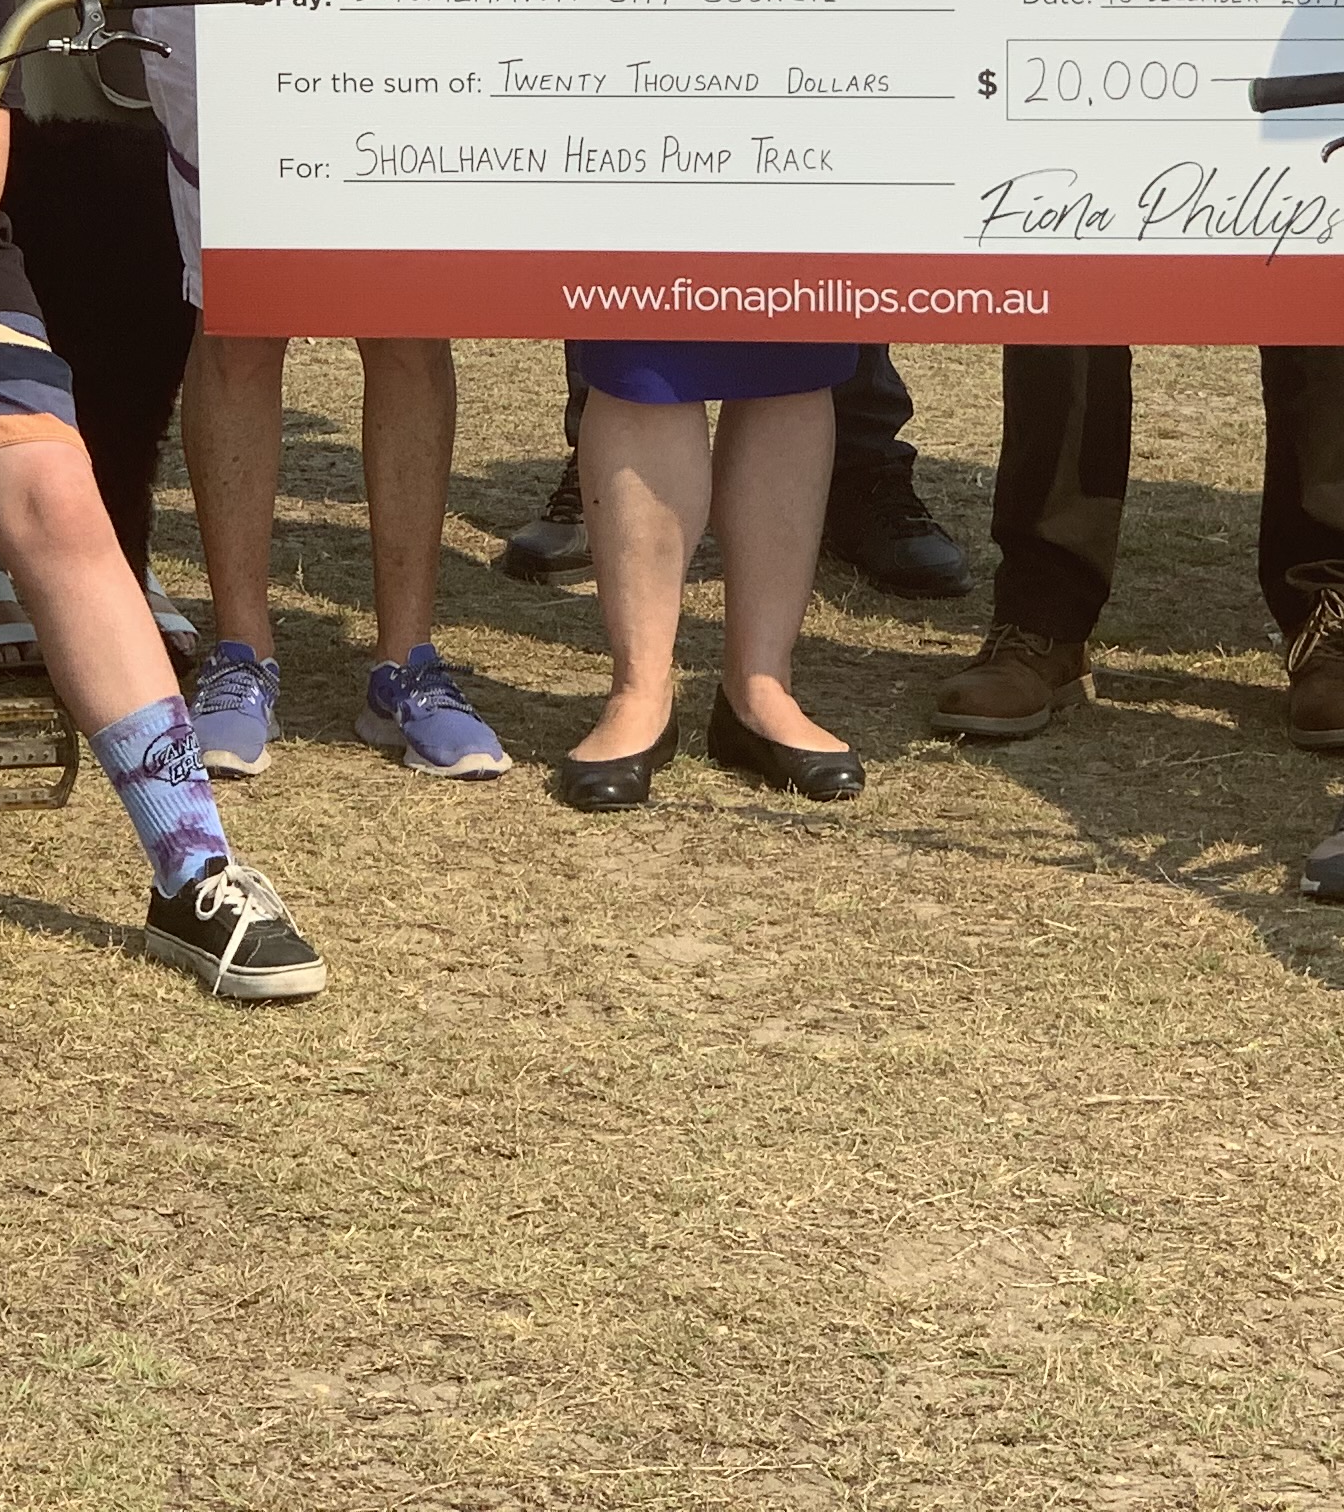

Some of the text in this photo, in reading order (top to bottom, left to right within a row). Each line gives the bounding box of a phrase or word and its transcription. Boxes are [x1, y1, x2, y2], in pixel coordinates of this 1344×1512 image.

[278, 58, 890, 95] For the sum of: TWENTY THOUSAND DOLLARS
[977, 57, 1200, 107] $ 20,000
[279, 131, 834, 180] For: SHOALHAVEN HEADS PUMP TRACK
[977, 168, 1116, 248] Fiona
[562, 277, 1050, 319] www.fionaphillips.com.au
